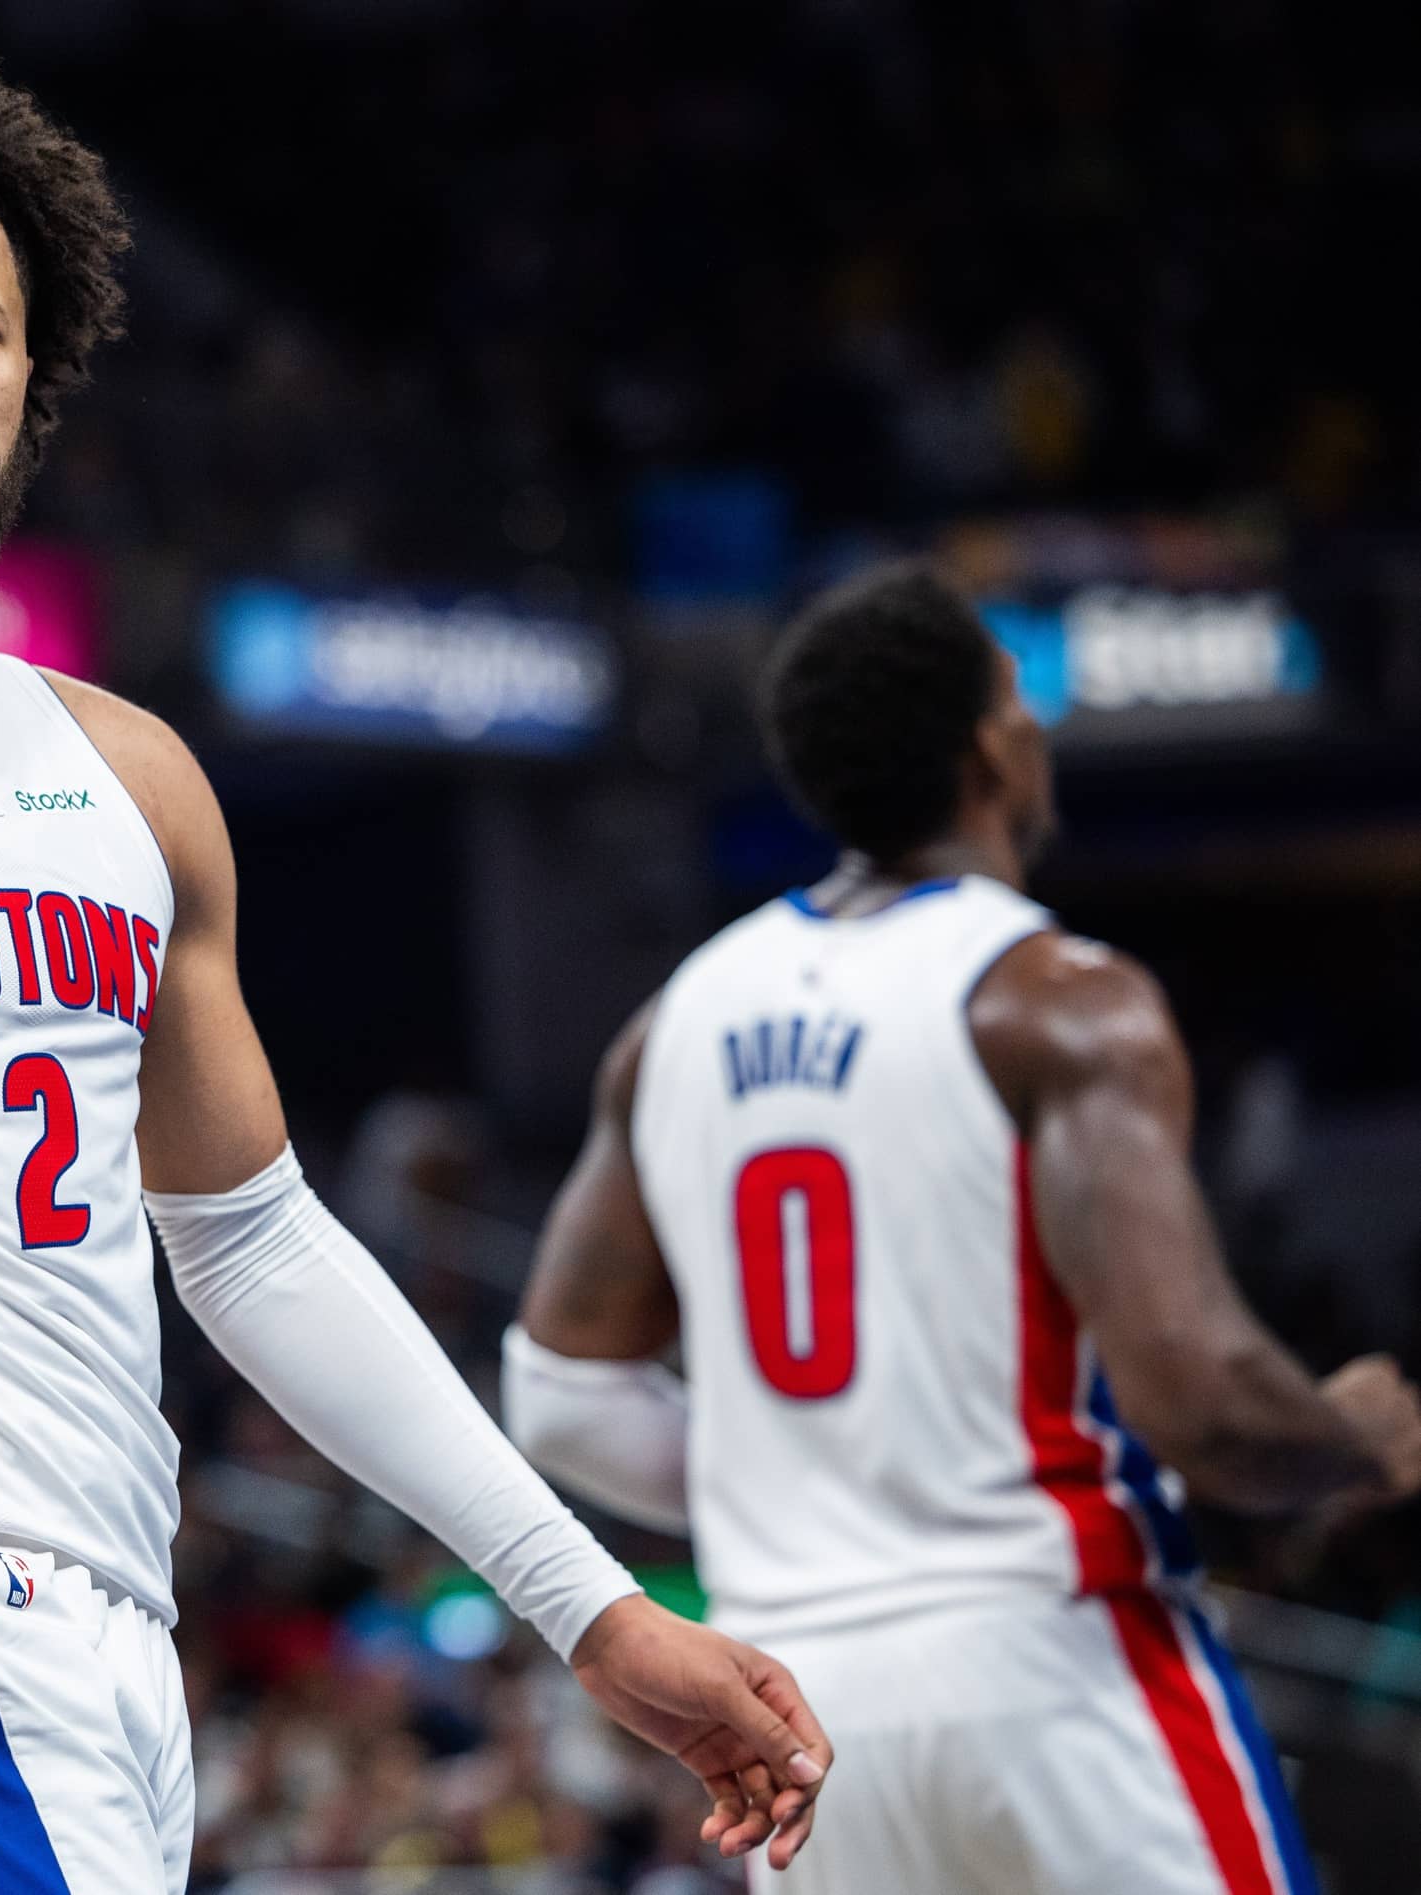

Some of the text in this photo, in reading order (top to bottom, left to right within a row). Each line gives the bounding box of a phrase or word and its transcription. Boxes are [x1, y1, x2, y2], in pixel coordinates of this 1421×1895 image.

[15, 788, 97, 812] StockX
[3, 1052, 91, 1250] 2
[734, 1146, 857, 1400] 0
